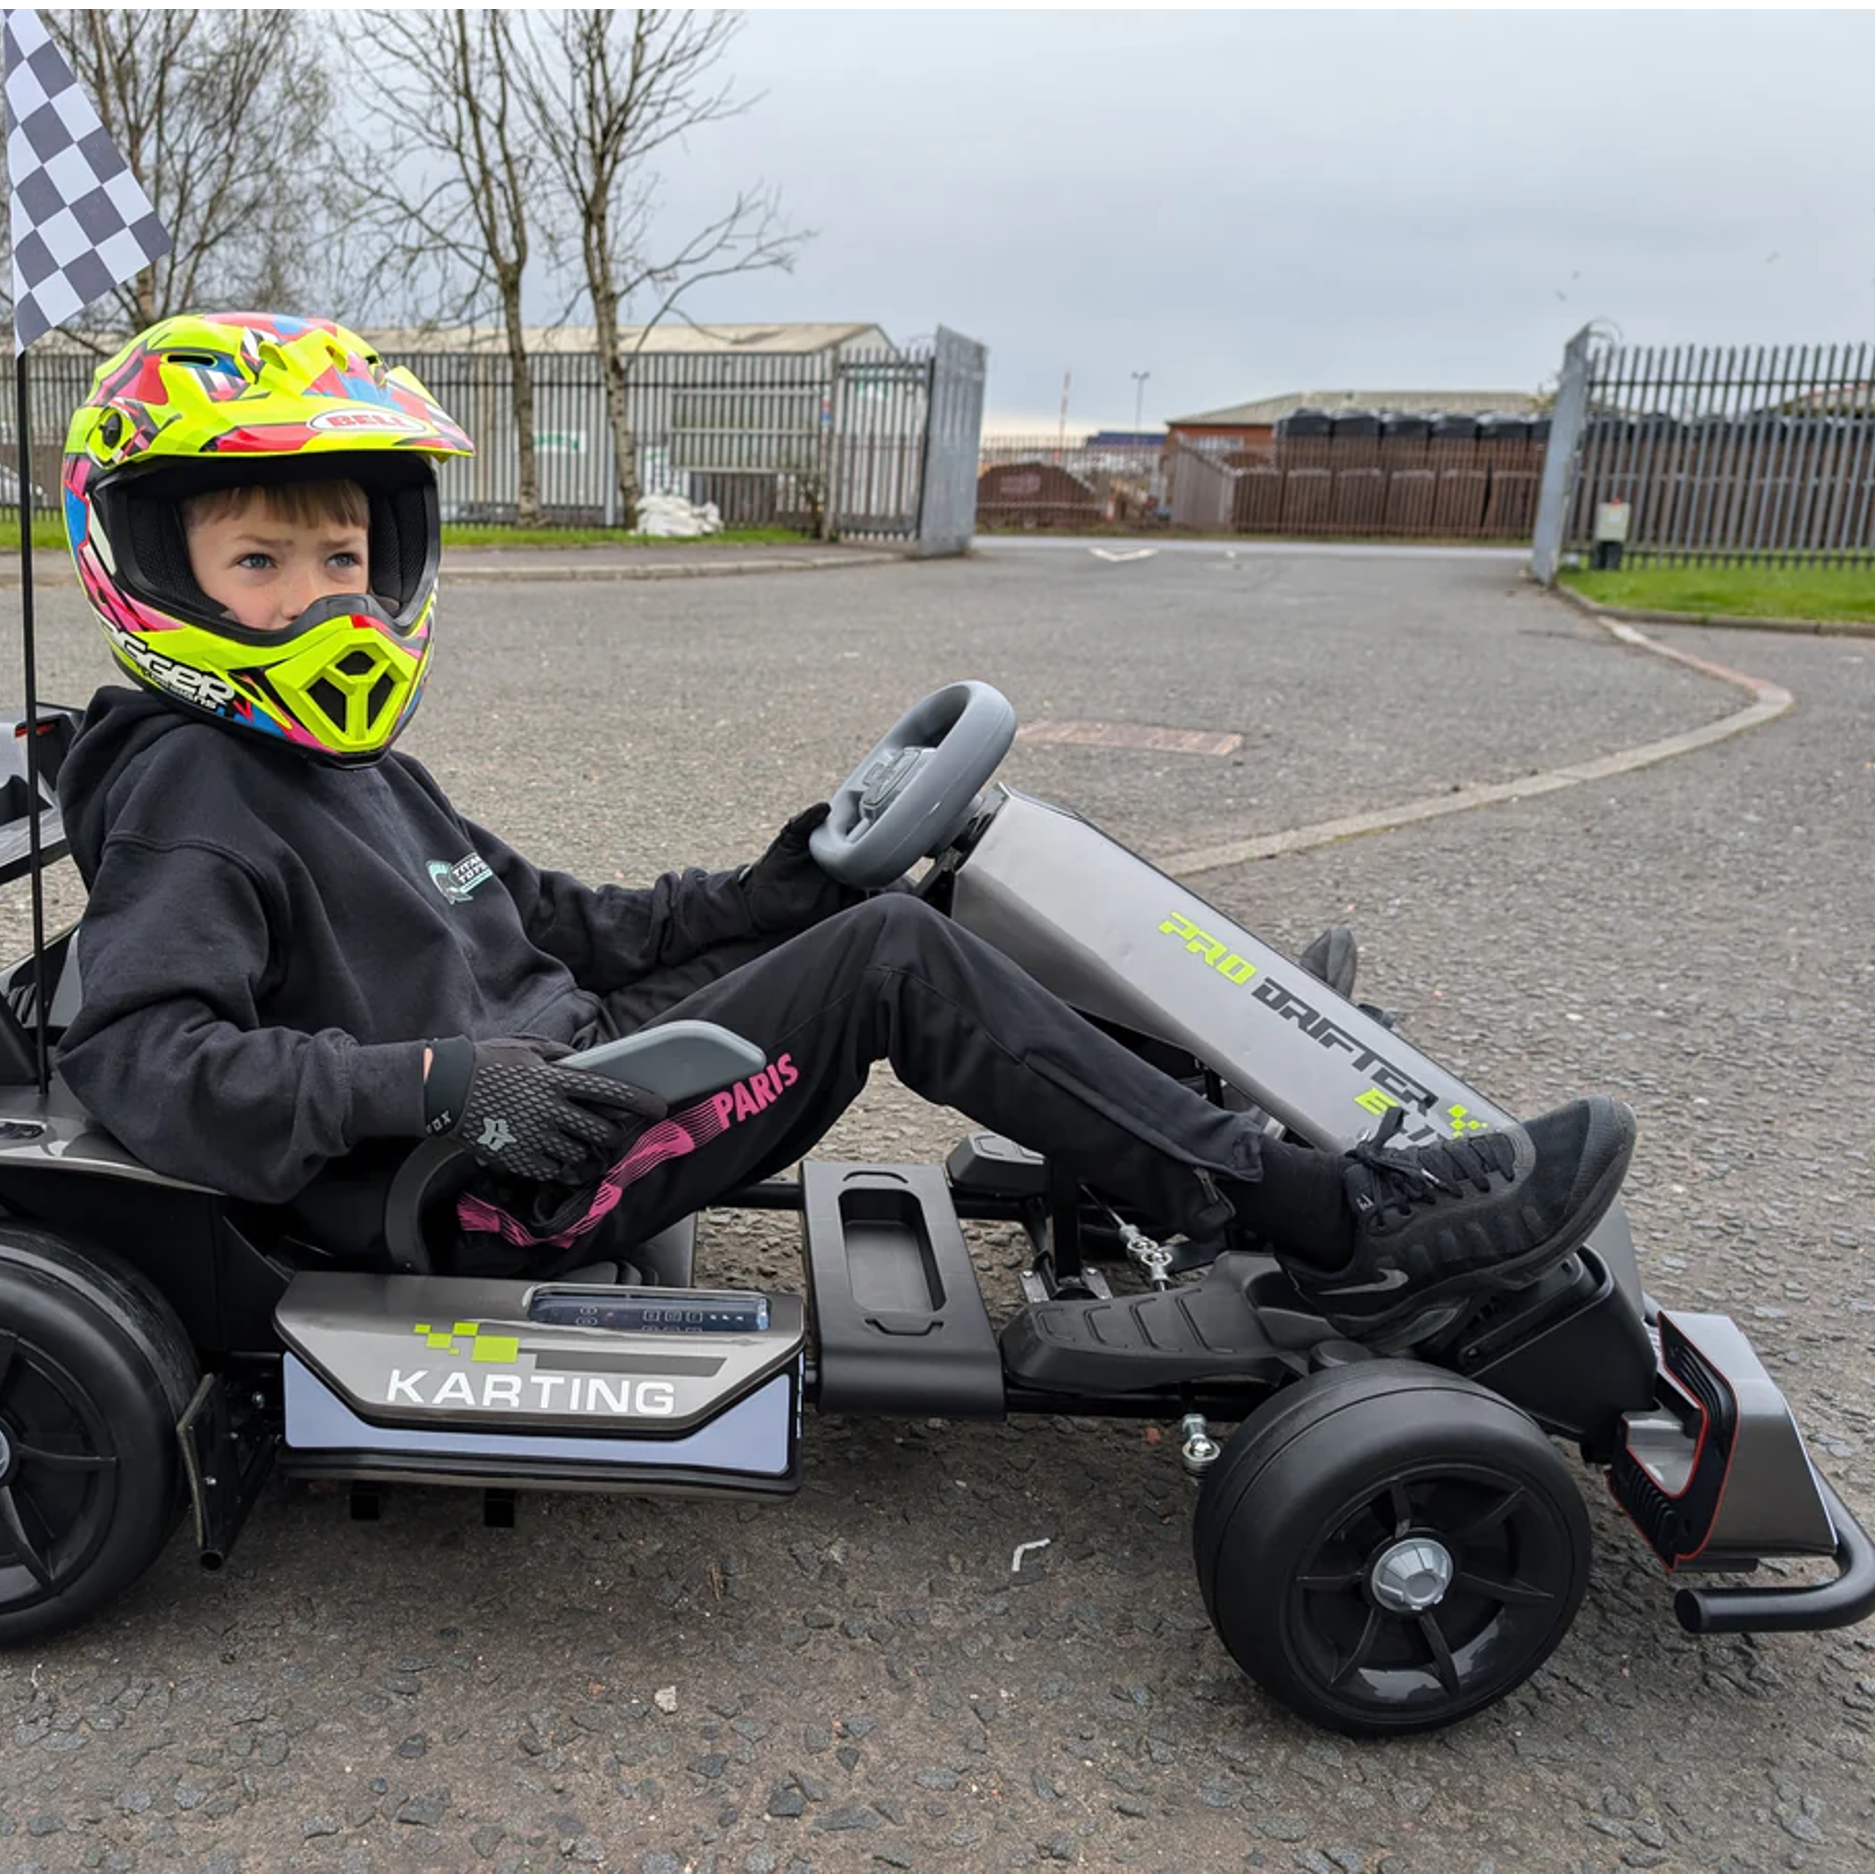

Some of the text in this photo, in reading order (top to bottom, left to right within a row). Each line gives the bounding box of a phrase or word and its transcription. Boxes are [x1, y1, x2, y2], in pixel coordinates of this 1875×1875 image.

[326, 414, 412, 428] BELL
[1158, 911, 1439, 1117] PRO DRIFTER
[712, 1053, 799, 1130] PARIS
[425, 1110, 452, 1134] FOX
[386, 1369, 675, 1415] KARTING
